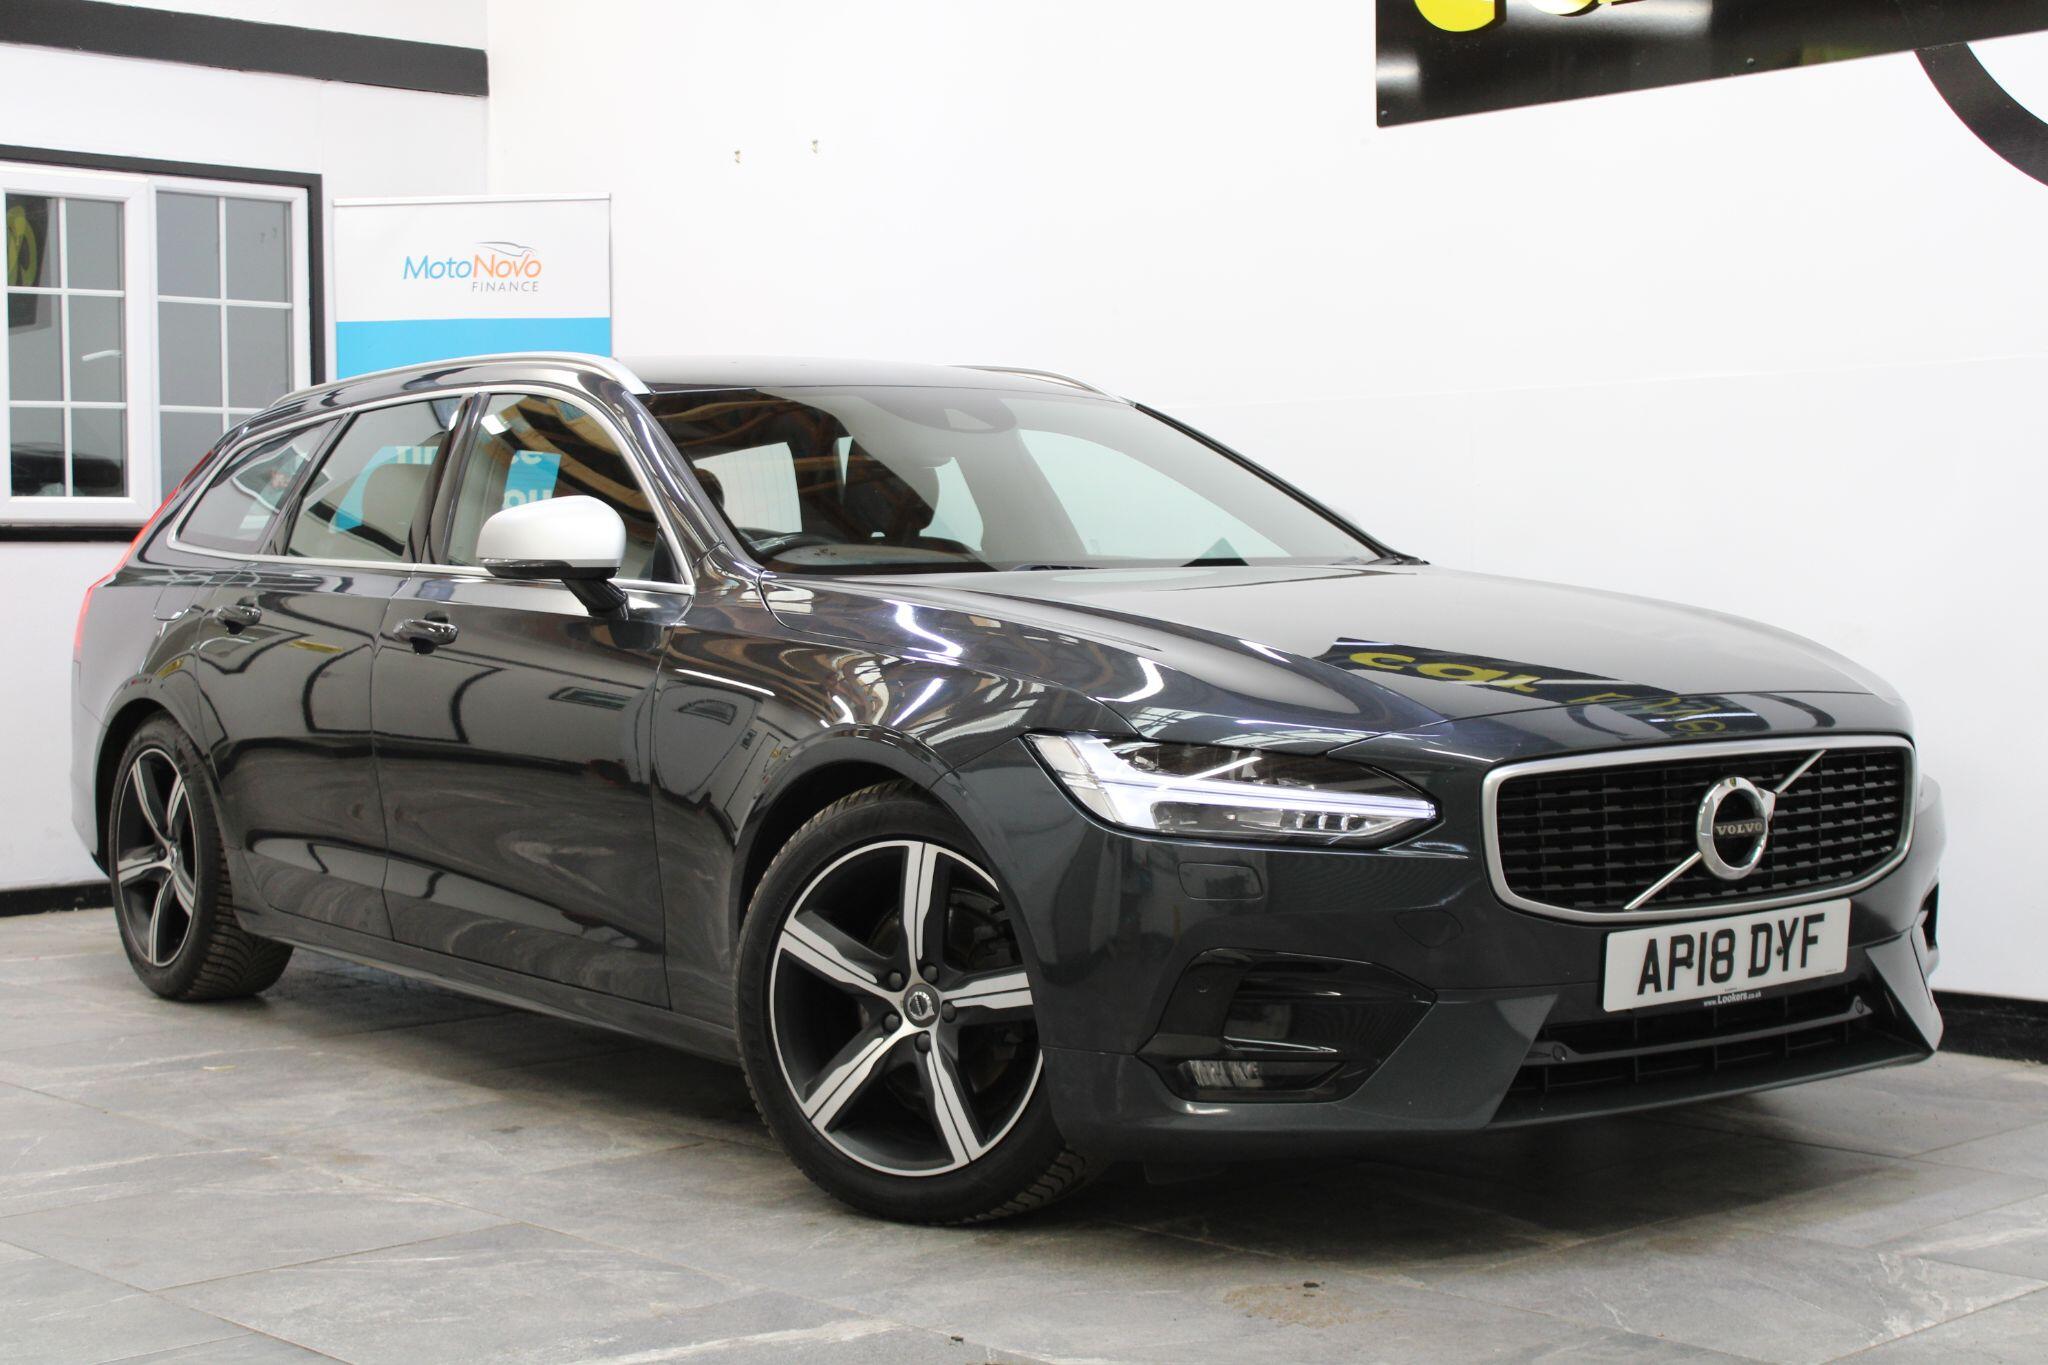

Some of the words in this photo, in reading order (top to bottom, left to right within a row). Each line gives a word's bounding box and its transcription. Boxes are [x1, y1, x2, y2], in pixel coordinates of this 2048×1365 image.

[403, 254, 542, 280] MotoNovo
[472, 281, 540, 292] FINANCE
[1716, 821, 1763, 836] VOLVO
[1637, 928, 1736, 995] AP18
[1748, 913, 1825, 978] DYF
